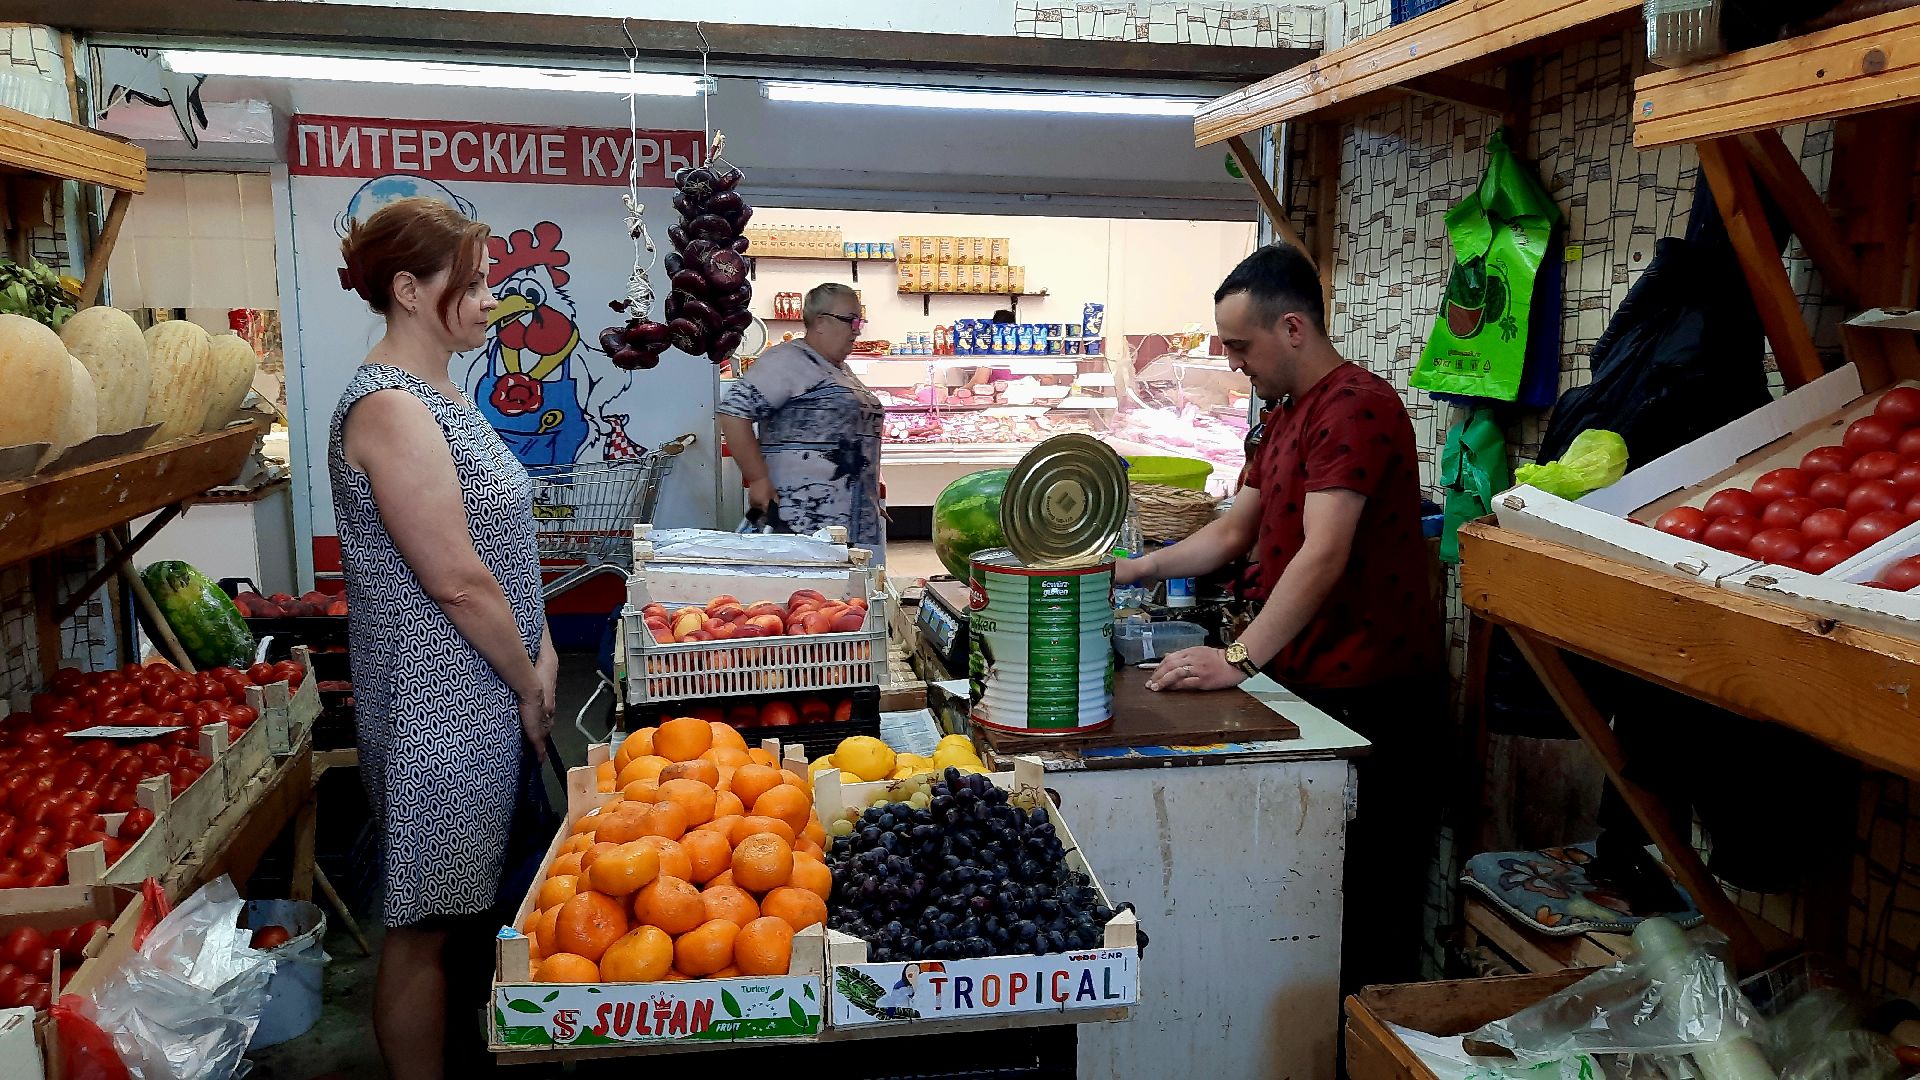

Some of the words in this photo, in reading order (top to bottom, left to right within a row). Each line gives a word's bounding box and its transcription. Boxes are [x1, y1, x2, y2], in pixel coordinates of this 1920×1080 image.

[297, 124, 567, 176] ПИТЕРСКИЕ
[582, 136, 699, 179] КУРЫ
[741, 985, 771, 994] Turkey
[929, 966, 1120, 1011] TROPICAL
[592, 997, 714, 1037] SULTAN
[715, 1021, 742, 1033] FRUIT
